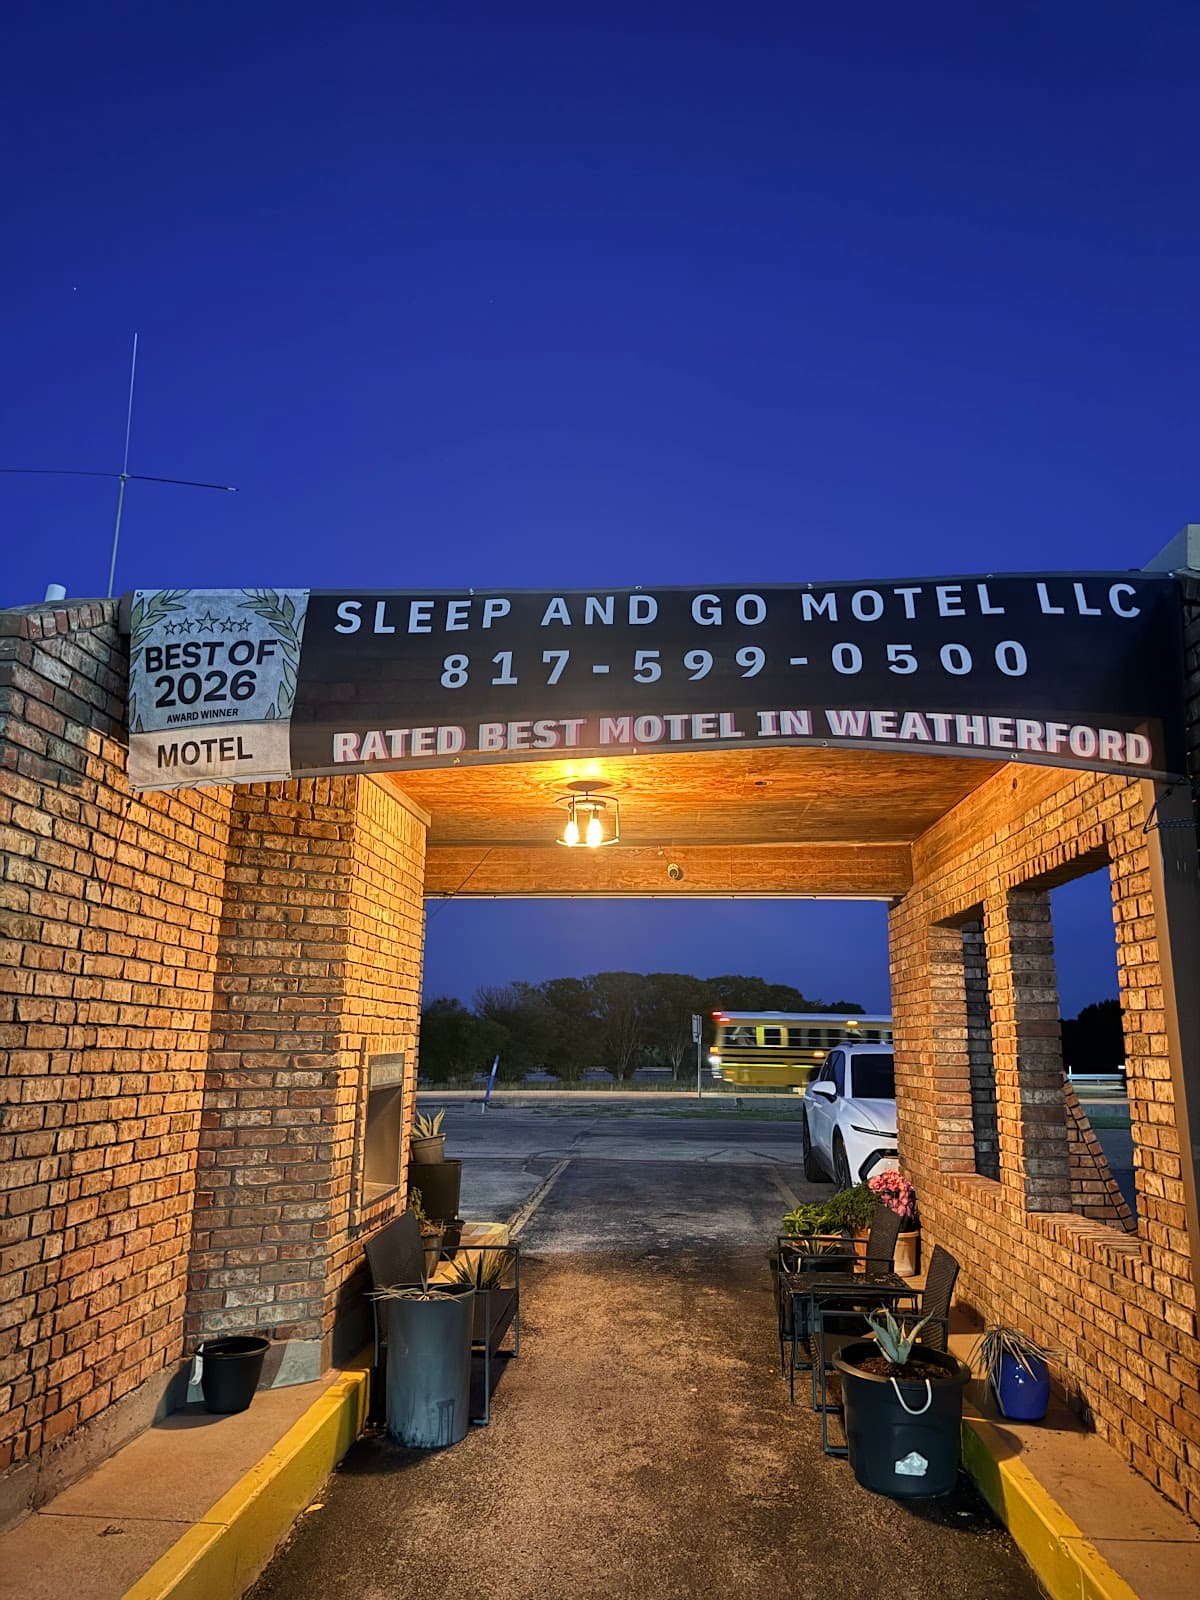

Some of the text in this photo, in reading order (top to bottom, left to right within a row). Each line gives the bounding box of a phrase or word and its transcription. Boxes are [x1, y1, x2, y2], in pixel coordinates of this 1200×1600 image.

[334, 582, 1141, 634] SLEEP AND GO MOTEL LLC
[145, 639, 278, 673] BEST OF
[156, 670, 257, 708] 2026
[166, 708, 239, 724] AWARD WINNER
[157, 736, 253, 769] MOTEL
[333, 710, 1153, 765] RATED BEST MOTEL IN WEATHERFORD
